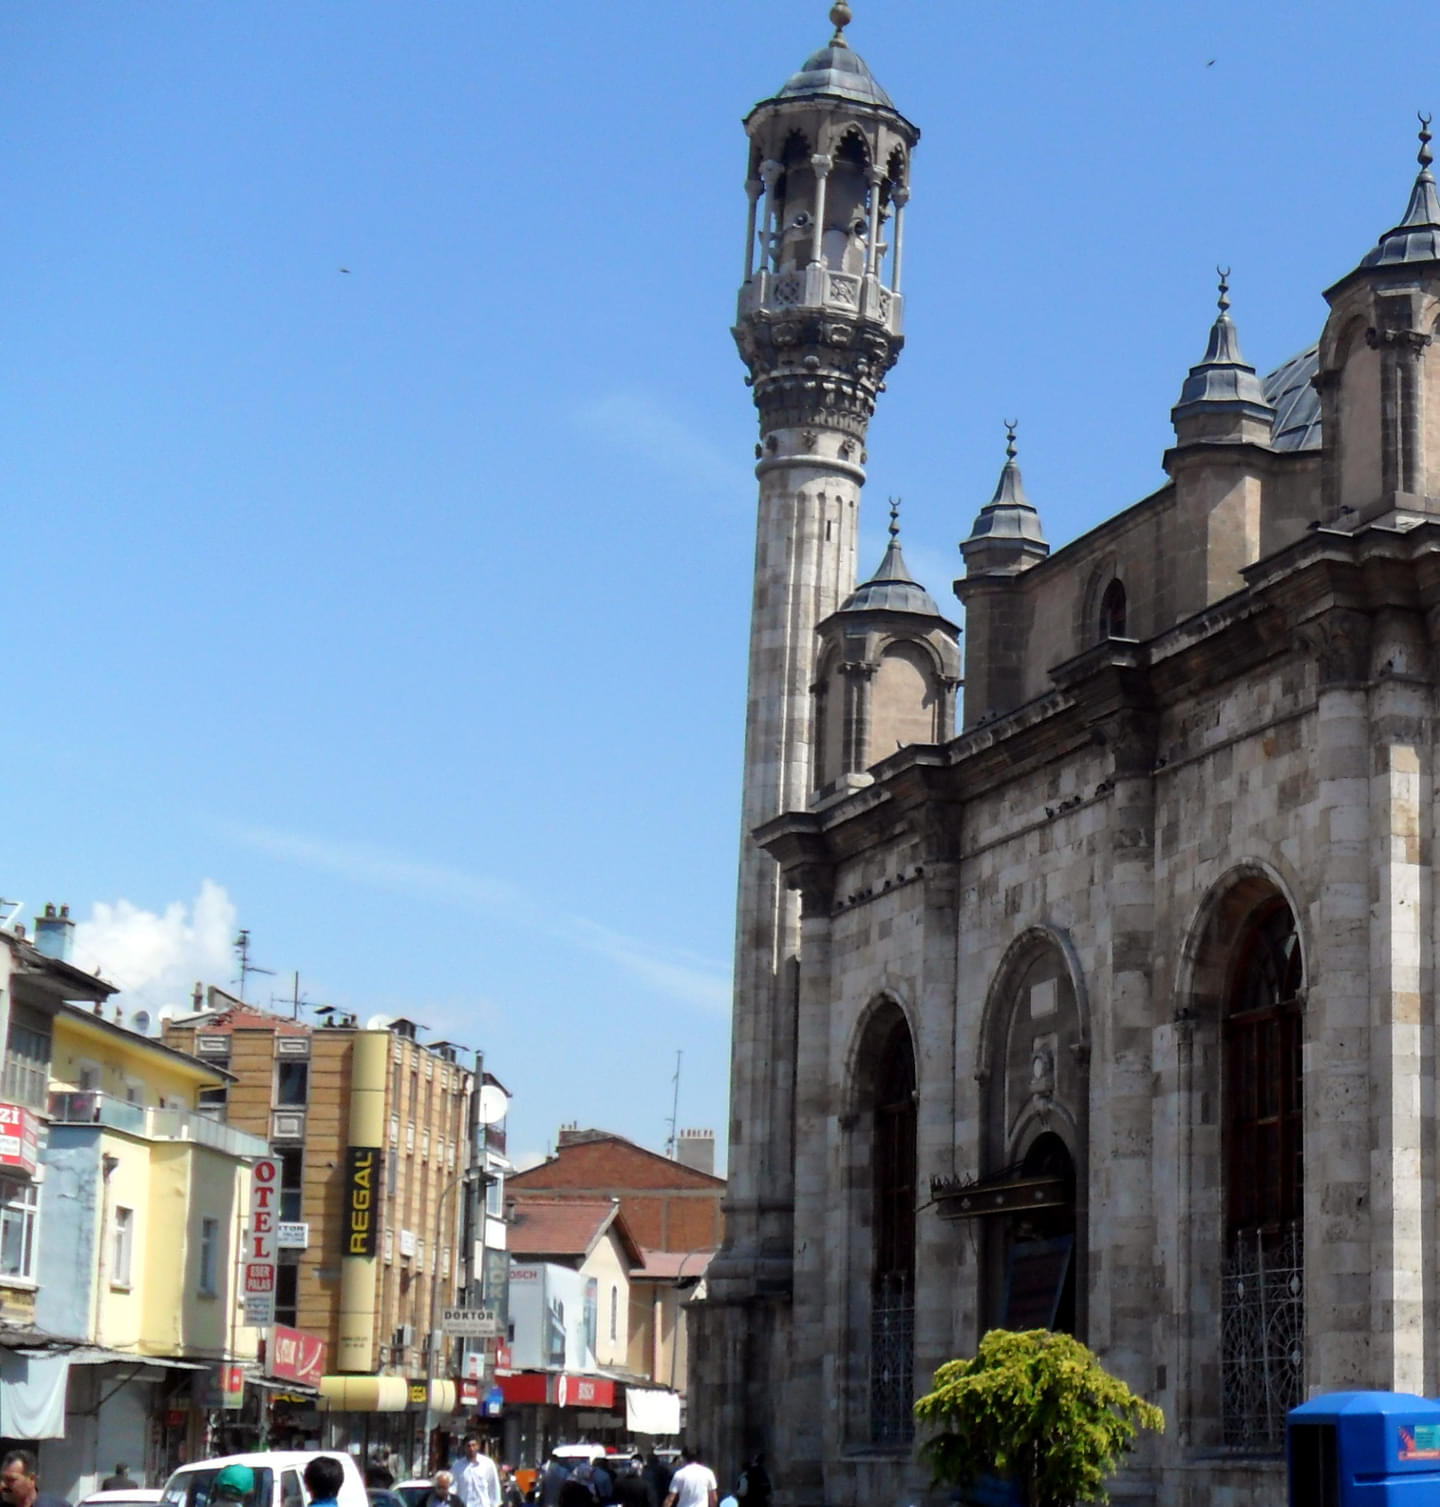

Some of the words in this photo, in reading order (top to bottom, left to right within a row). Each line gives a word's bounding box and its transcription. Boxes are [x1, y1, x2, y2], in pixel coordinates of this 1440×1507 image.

[350, 1152, 372, 1253] REGAL
[254, 1161, 276, 1258] OTEL
[510, 1270, 537, 1279] OSCH
[247, 1278, 271, 1289] PALAS
[444, 1311, 494, 1320] DOKTOR
